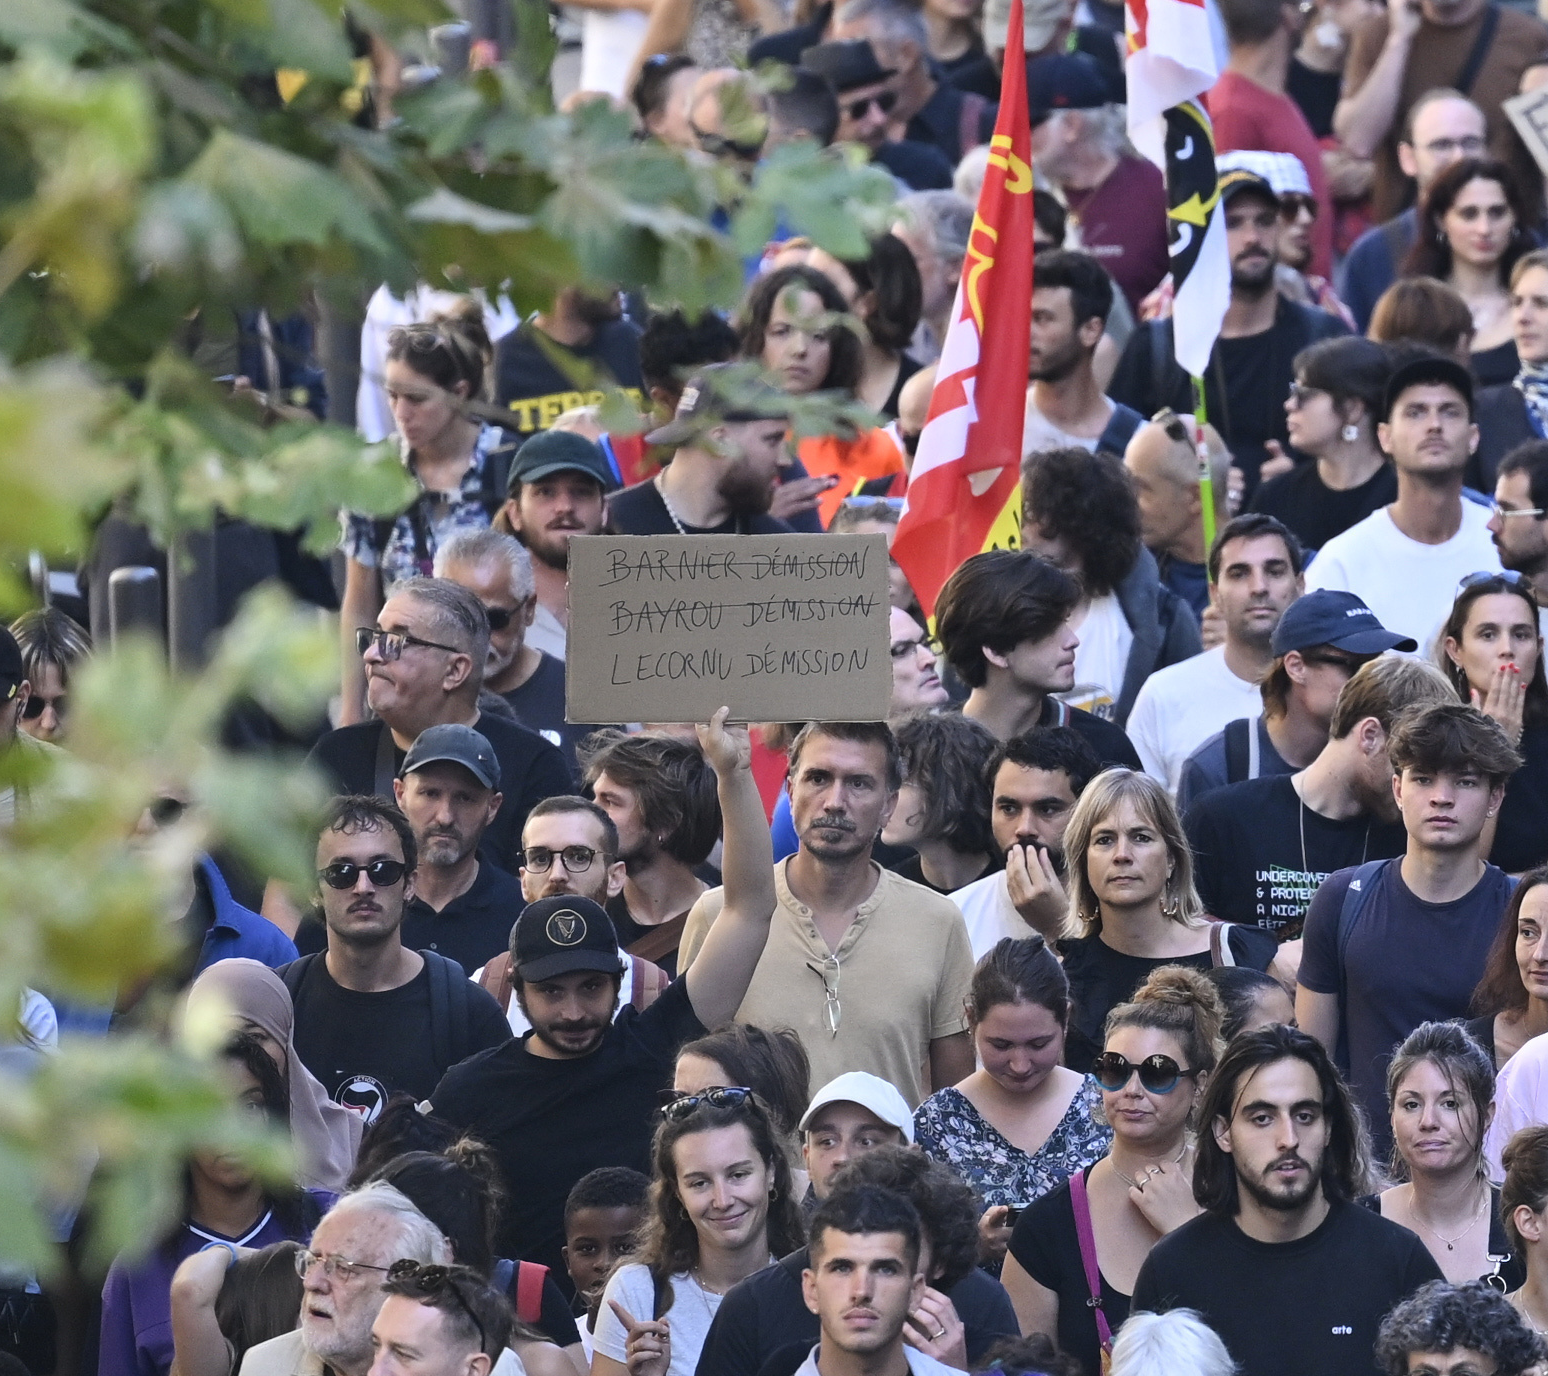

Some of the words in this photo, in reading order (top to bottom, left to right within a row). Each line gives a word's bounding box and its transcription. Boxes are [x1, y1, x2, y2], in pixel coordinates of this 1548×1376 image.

[608, 596, 723, 637] BAYROU
[611, 648, 734, 685] LECORNU
[1331, 1325, 1353, 1336] arte
